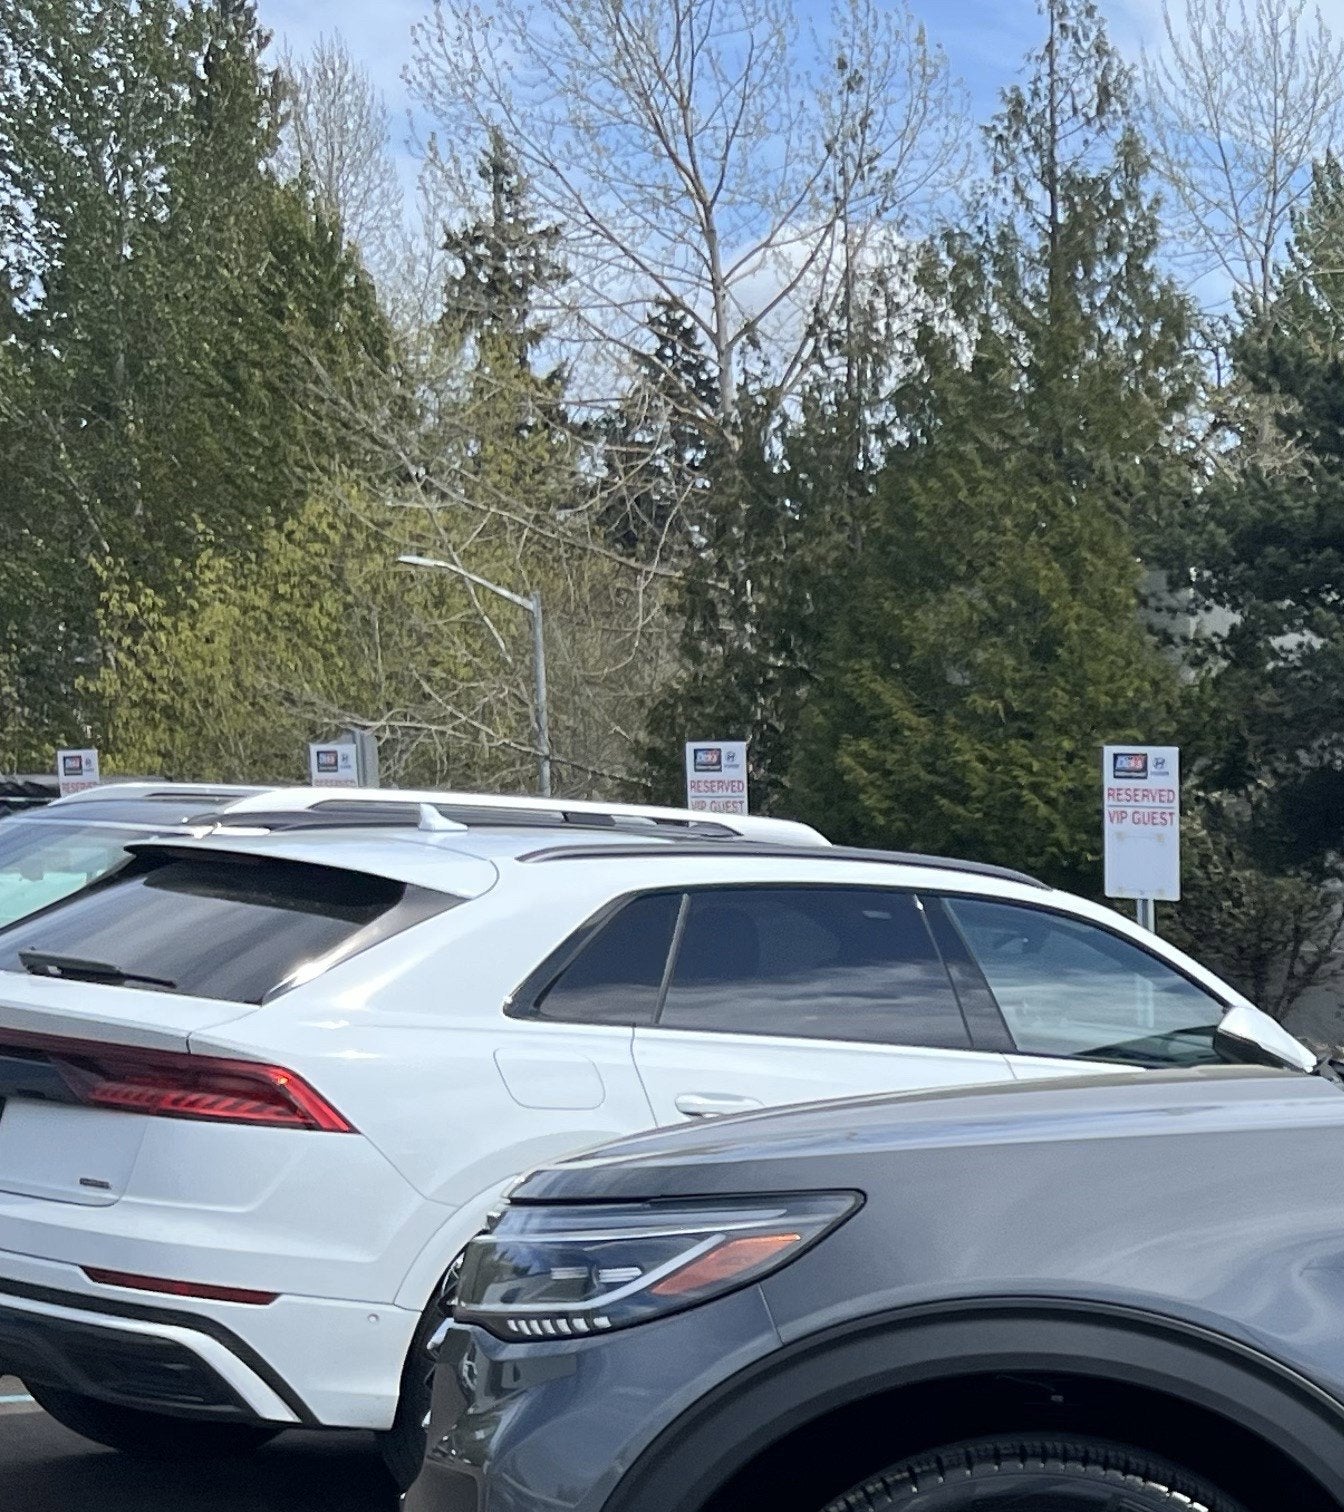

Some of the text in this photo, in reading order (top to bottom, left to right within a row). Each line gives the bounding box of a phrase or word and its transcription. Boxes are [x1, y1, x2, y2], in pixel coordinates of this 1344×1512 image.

[690, 780, 745, 793] RESERVED
[1107, 787, 1175, 804] RESERVED
[1108, 810, 1175, 826] VIP GUEST
